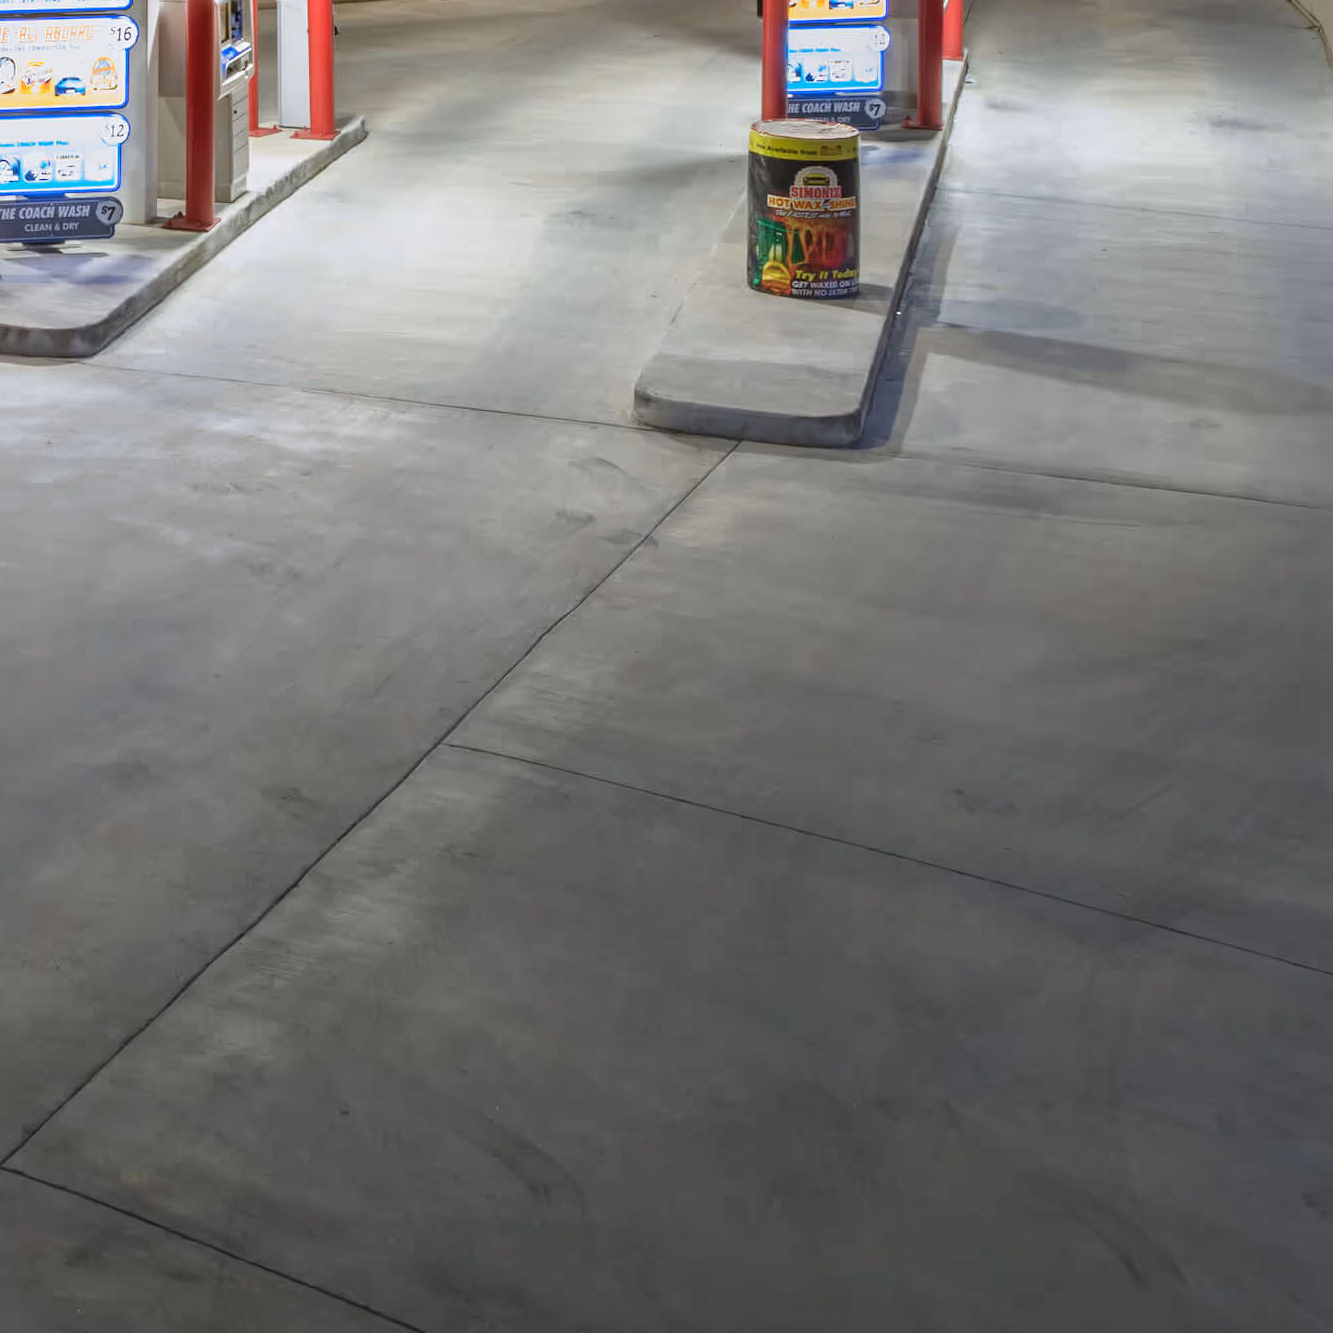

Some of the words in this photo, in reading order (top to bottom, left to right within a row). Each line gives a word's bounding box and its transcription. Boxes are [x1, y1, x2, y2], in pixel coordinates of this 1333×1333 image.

[109, 25, 133, 42] $16
[788, 103, 800, 114] HE
[801, 102, 831, 114] COACH
[832, 101, 861, 113] WASH
[869, 103, 881, 115] $7
[104, 122, 125, 138] $12
[790, 186, 841, 198] SIMONIZ
[768, 196, 790, 208] HOT
[793, 198, 824, 210] WAX
[19, 206, 56, 219] COACH
[57, 204, 91, 218] WASH
[101, 205, 116, 221] $7
[24, 222, 53, 232] CLEAN
[54, 222, 61, 231] &
[61, 221, 79, 231] DRY
[796, 269, 816, 282] Try
[792, 280, 809, 289] GET
